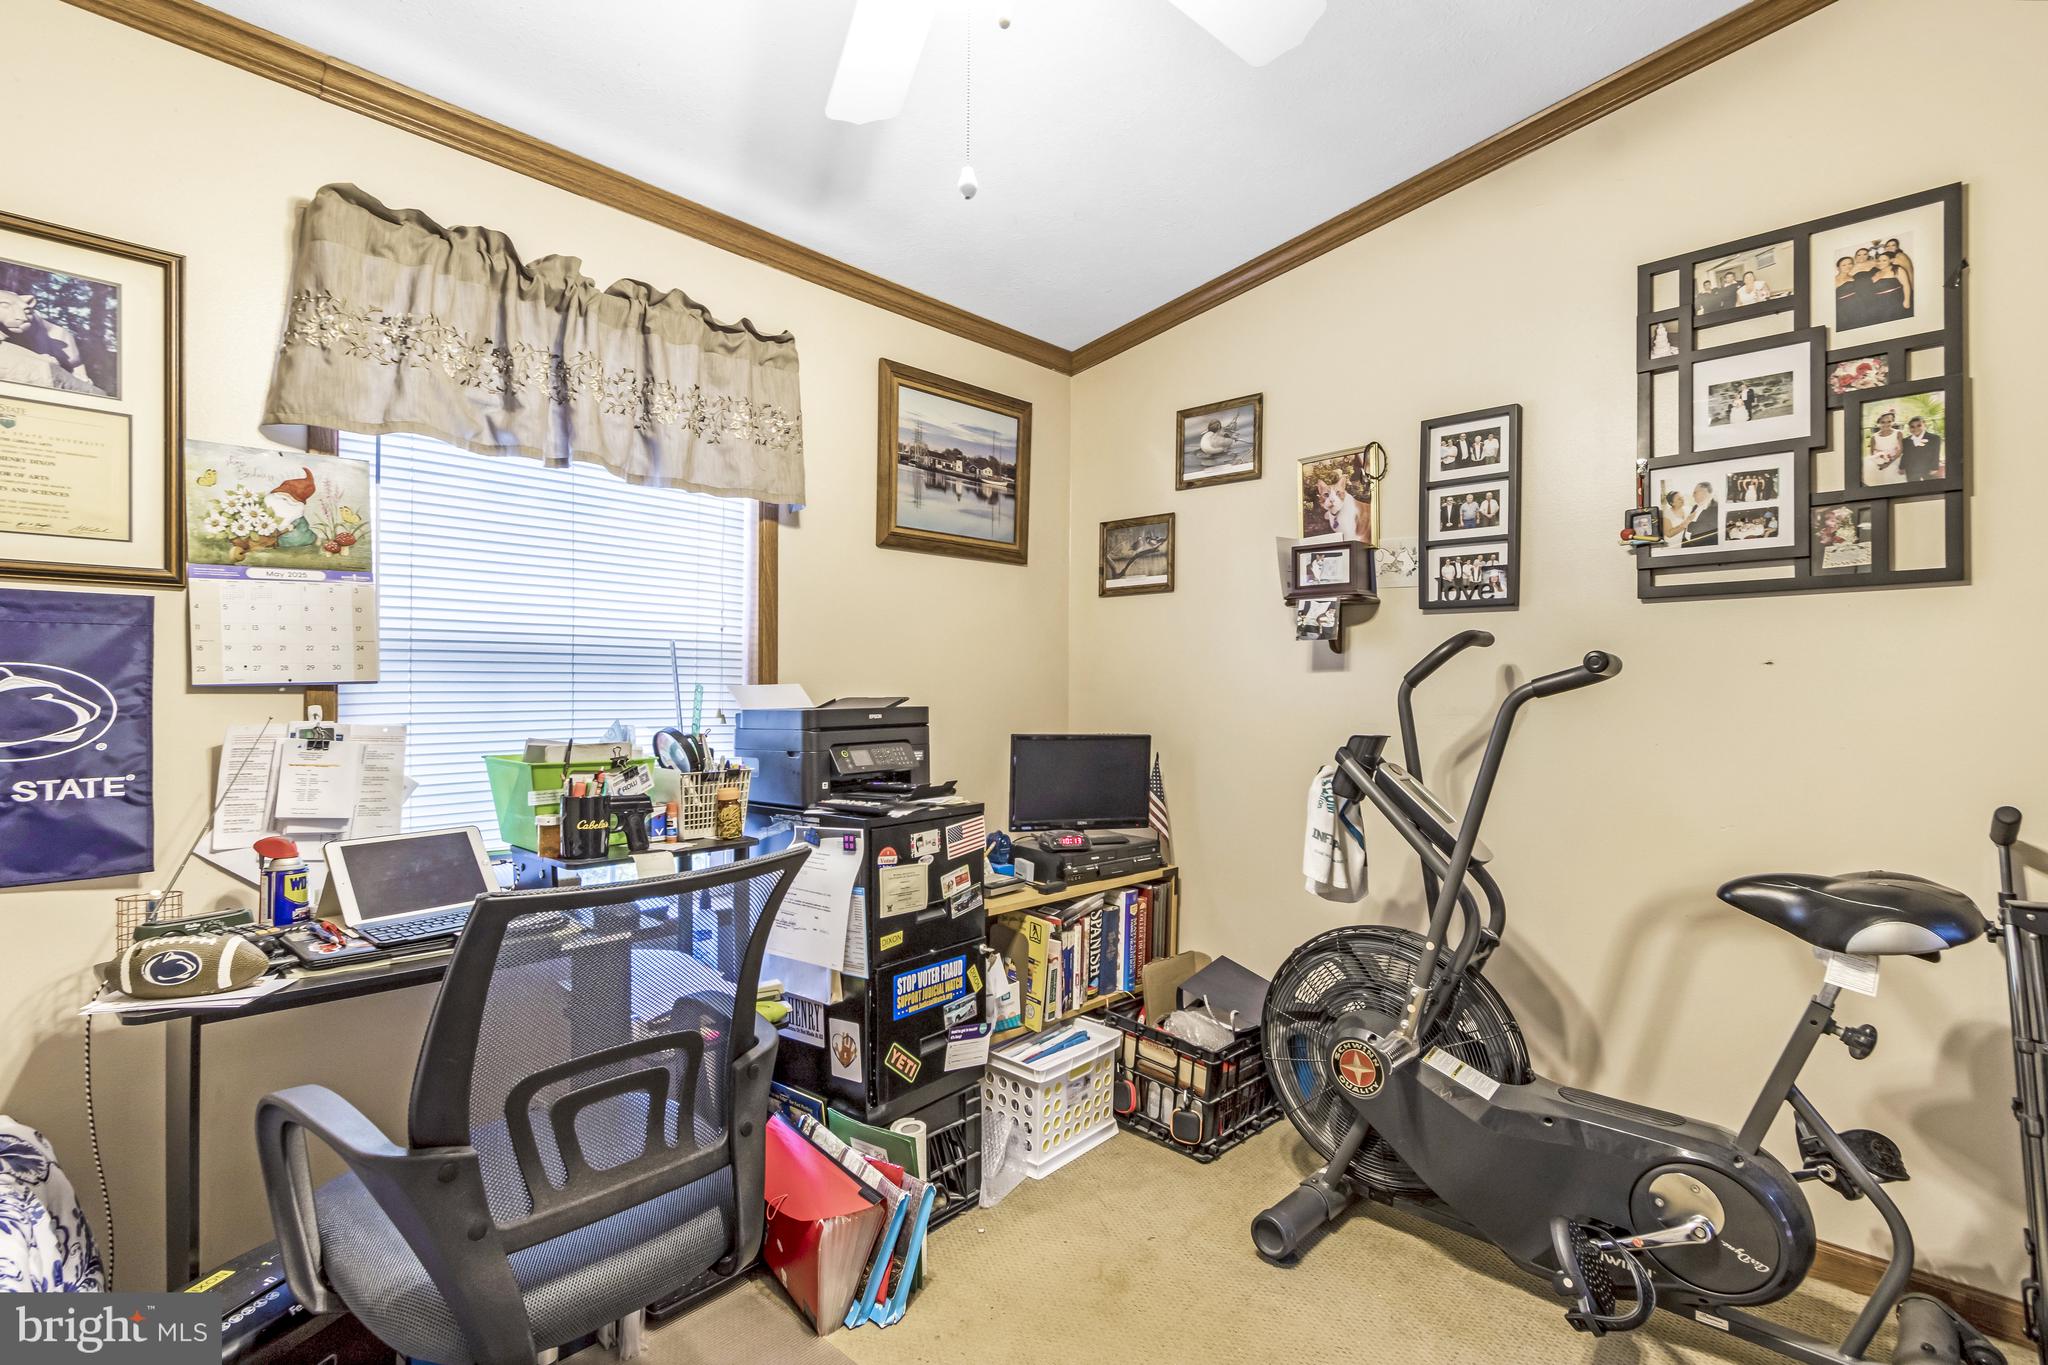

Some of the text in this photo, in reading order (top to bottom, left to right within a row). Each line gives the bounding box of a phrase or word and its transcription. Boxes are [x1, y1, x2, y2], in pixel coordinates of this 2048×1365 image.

[266, 571, 308, 580] May 2025
[1434, 576, 1495, 601] love
[881, 935, 902, 947] DIXON
[1090, 909, 1103, 978] SPANISH
[897, 959, 963, 995] STOP VOTER FRAUD
[969, 967, 980, 990] DIXON
[897, 976, 963, 1009] SUPPORT JUDICIAL WATCH
[788, 997, 820, 1032] HENRY
[891, 1048, 918, 1077] YETI
[1335, 1042, 1380, 1067] SCHWINN
[1339, 1074, 1380, 1095] QUALITY
